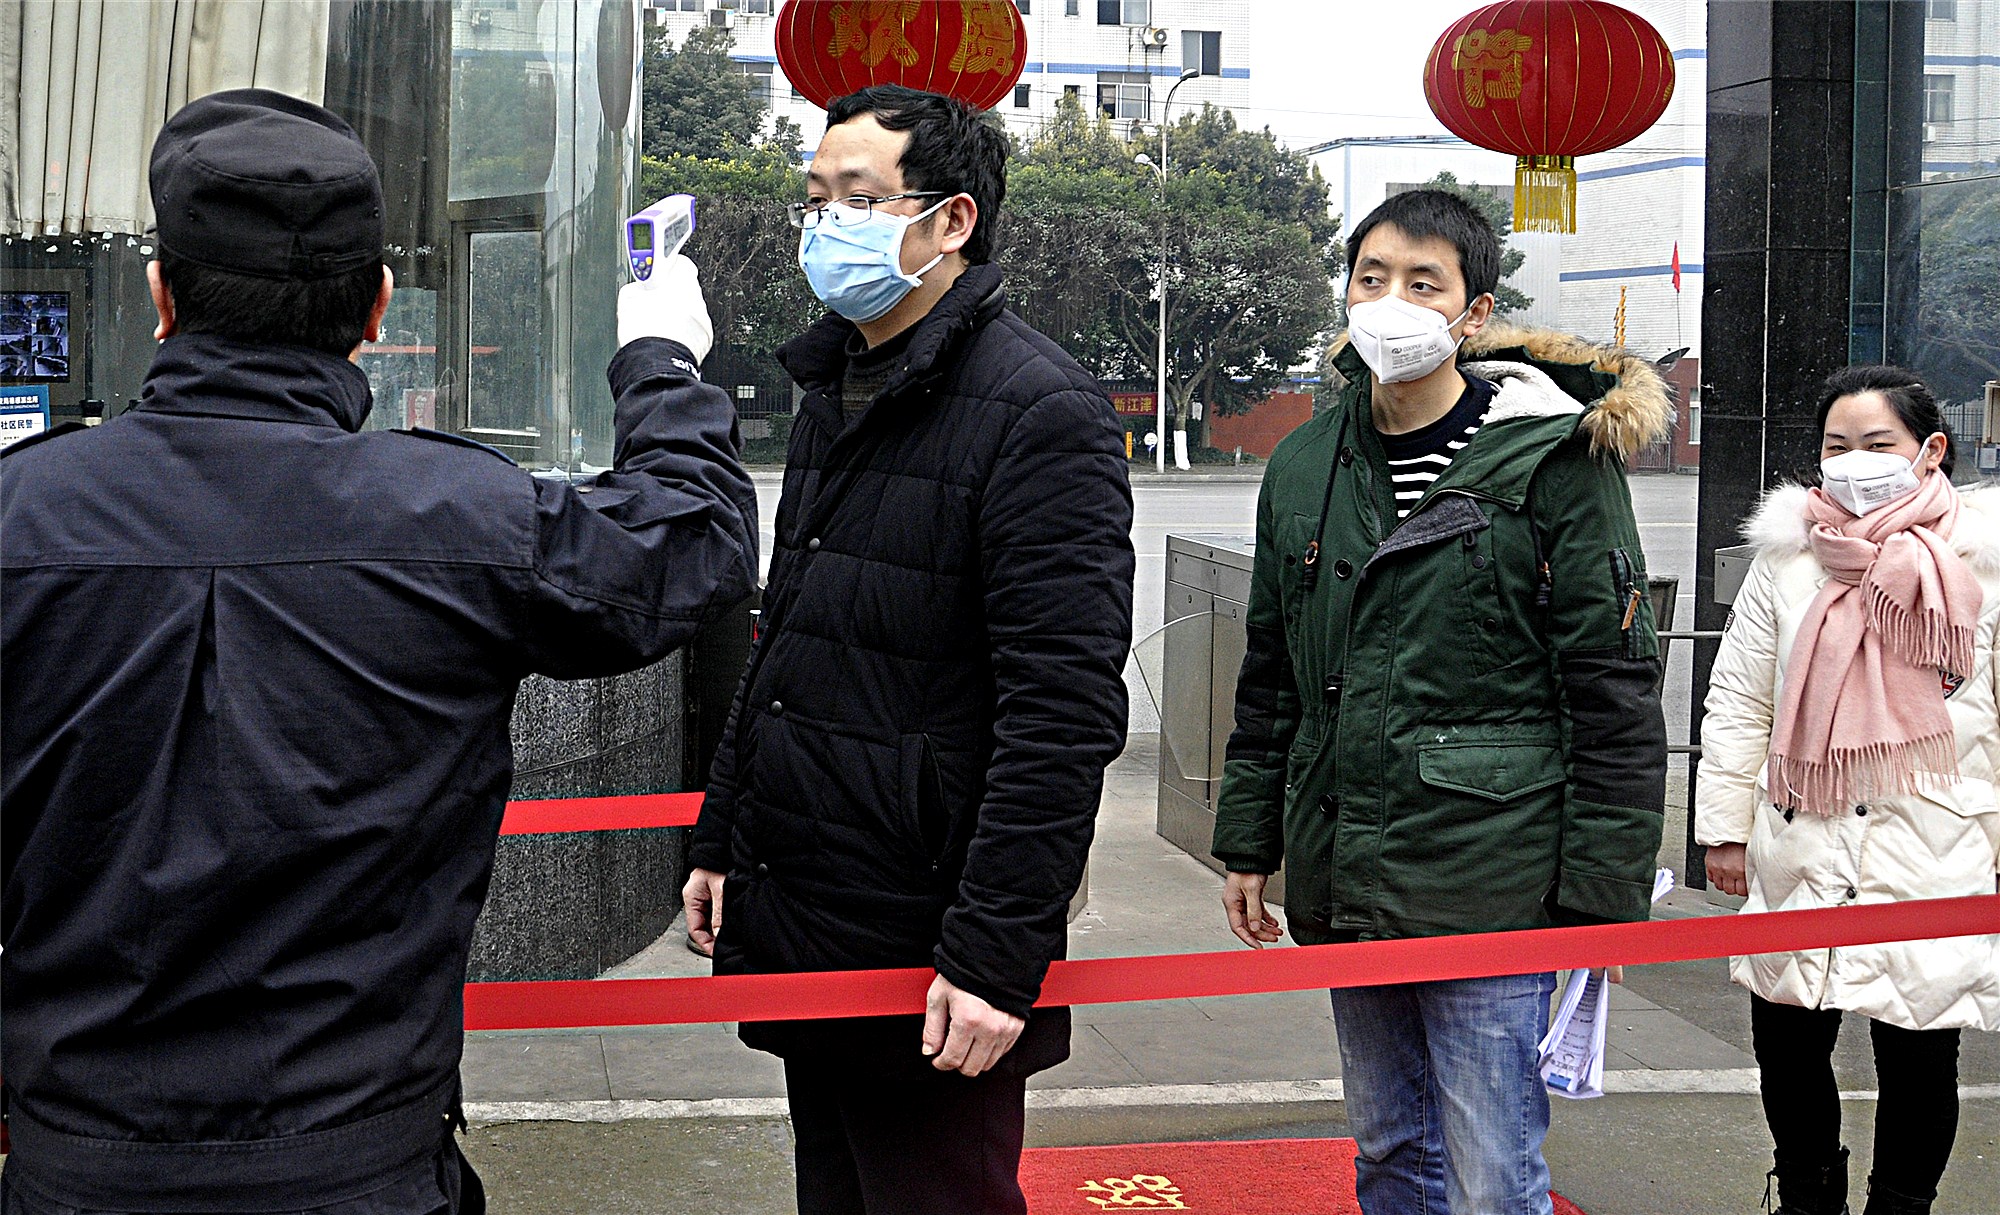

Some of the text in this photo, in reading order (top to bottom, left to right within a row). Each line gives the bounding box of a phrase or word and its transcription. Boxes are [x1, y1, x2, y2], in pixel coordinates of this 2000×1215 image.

[1114, 396, 1152, 412] 新江津
[1, 419, 33, 429] 社区民警
